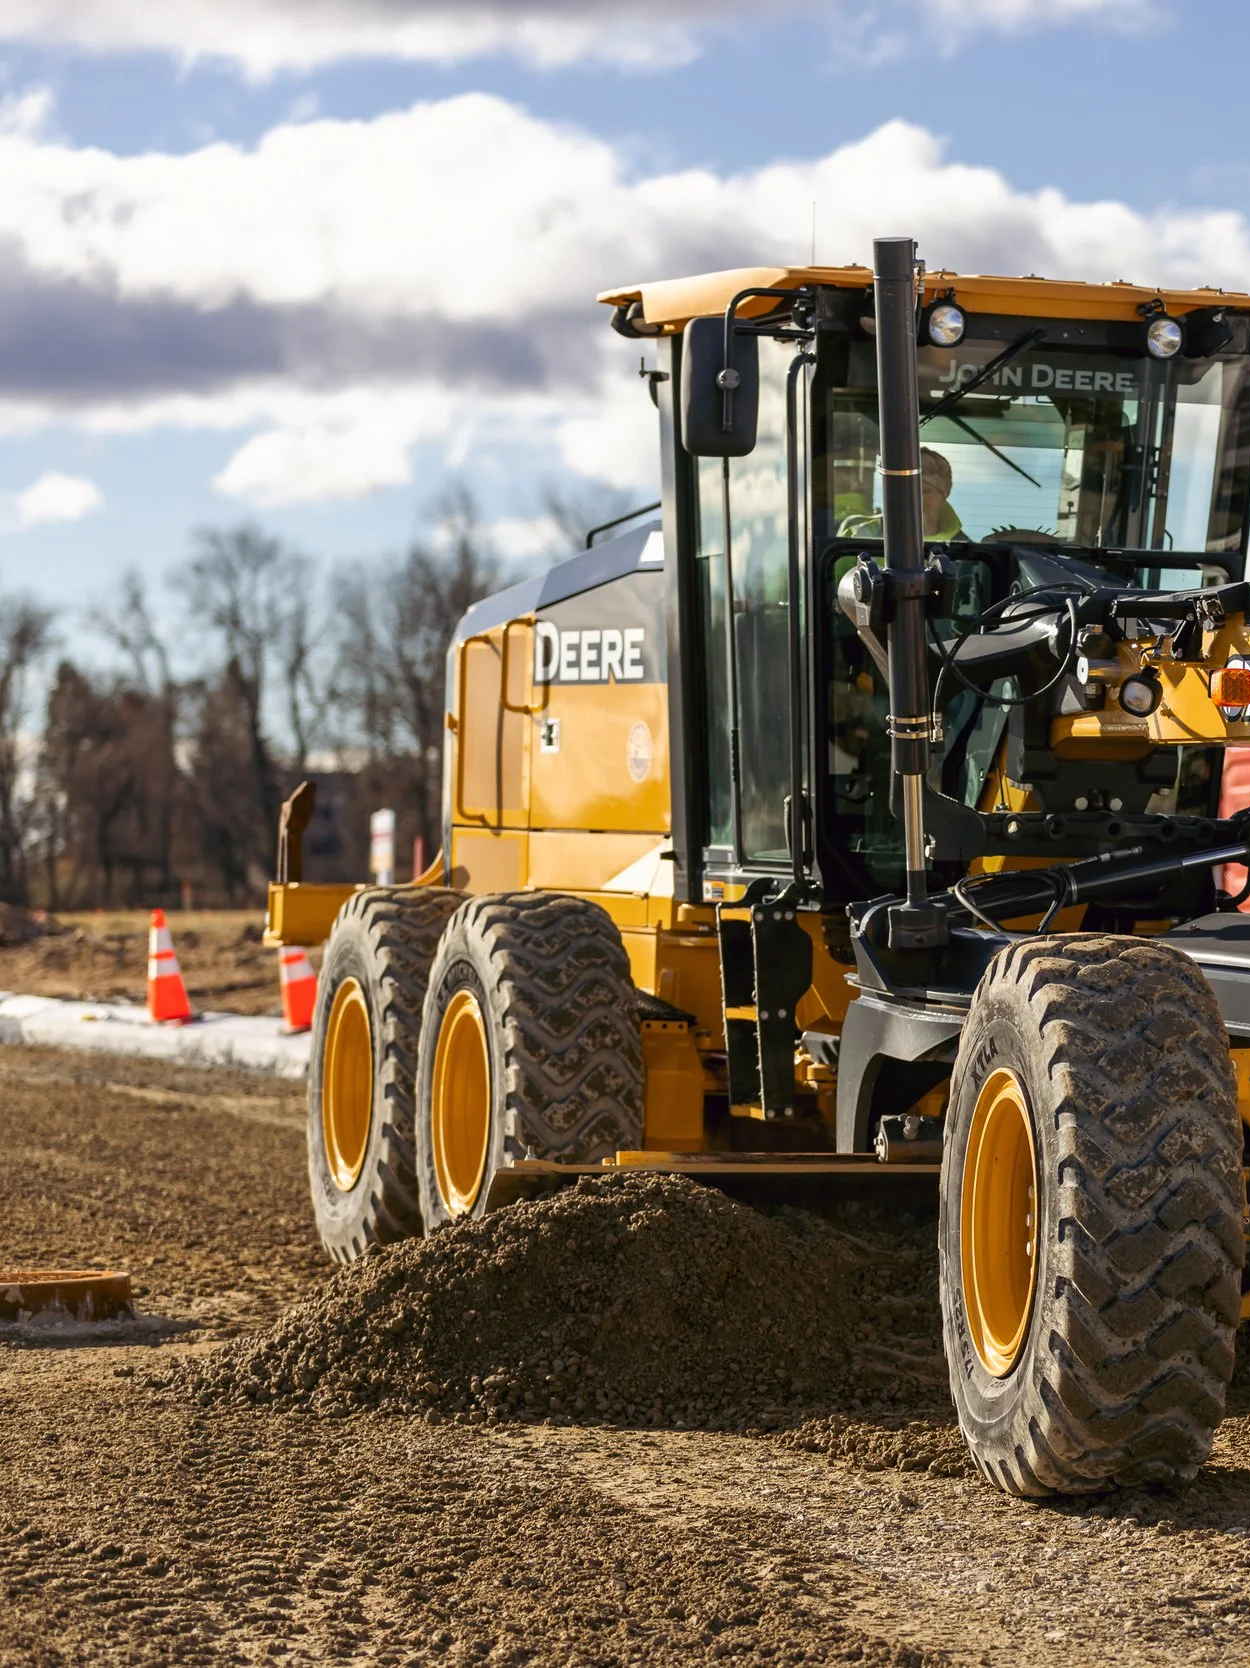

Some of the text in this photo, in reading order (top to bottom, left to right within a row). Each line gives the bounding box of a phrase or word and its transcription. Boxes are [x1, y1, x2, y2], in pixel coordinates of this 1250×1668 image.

[1031, 364, 1135, 393] DEERE
[535, 621, 645, 682] DEERE
[970, 1035, 999, 1092] XTLA
